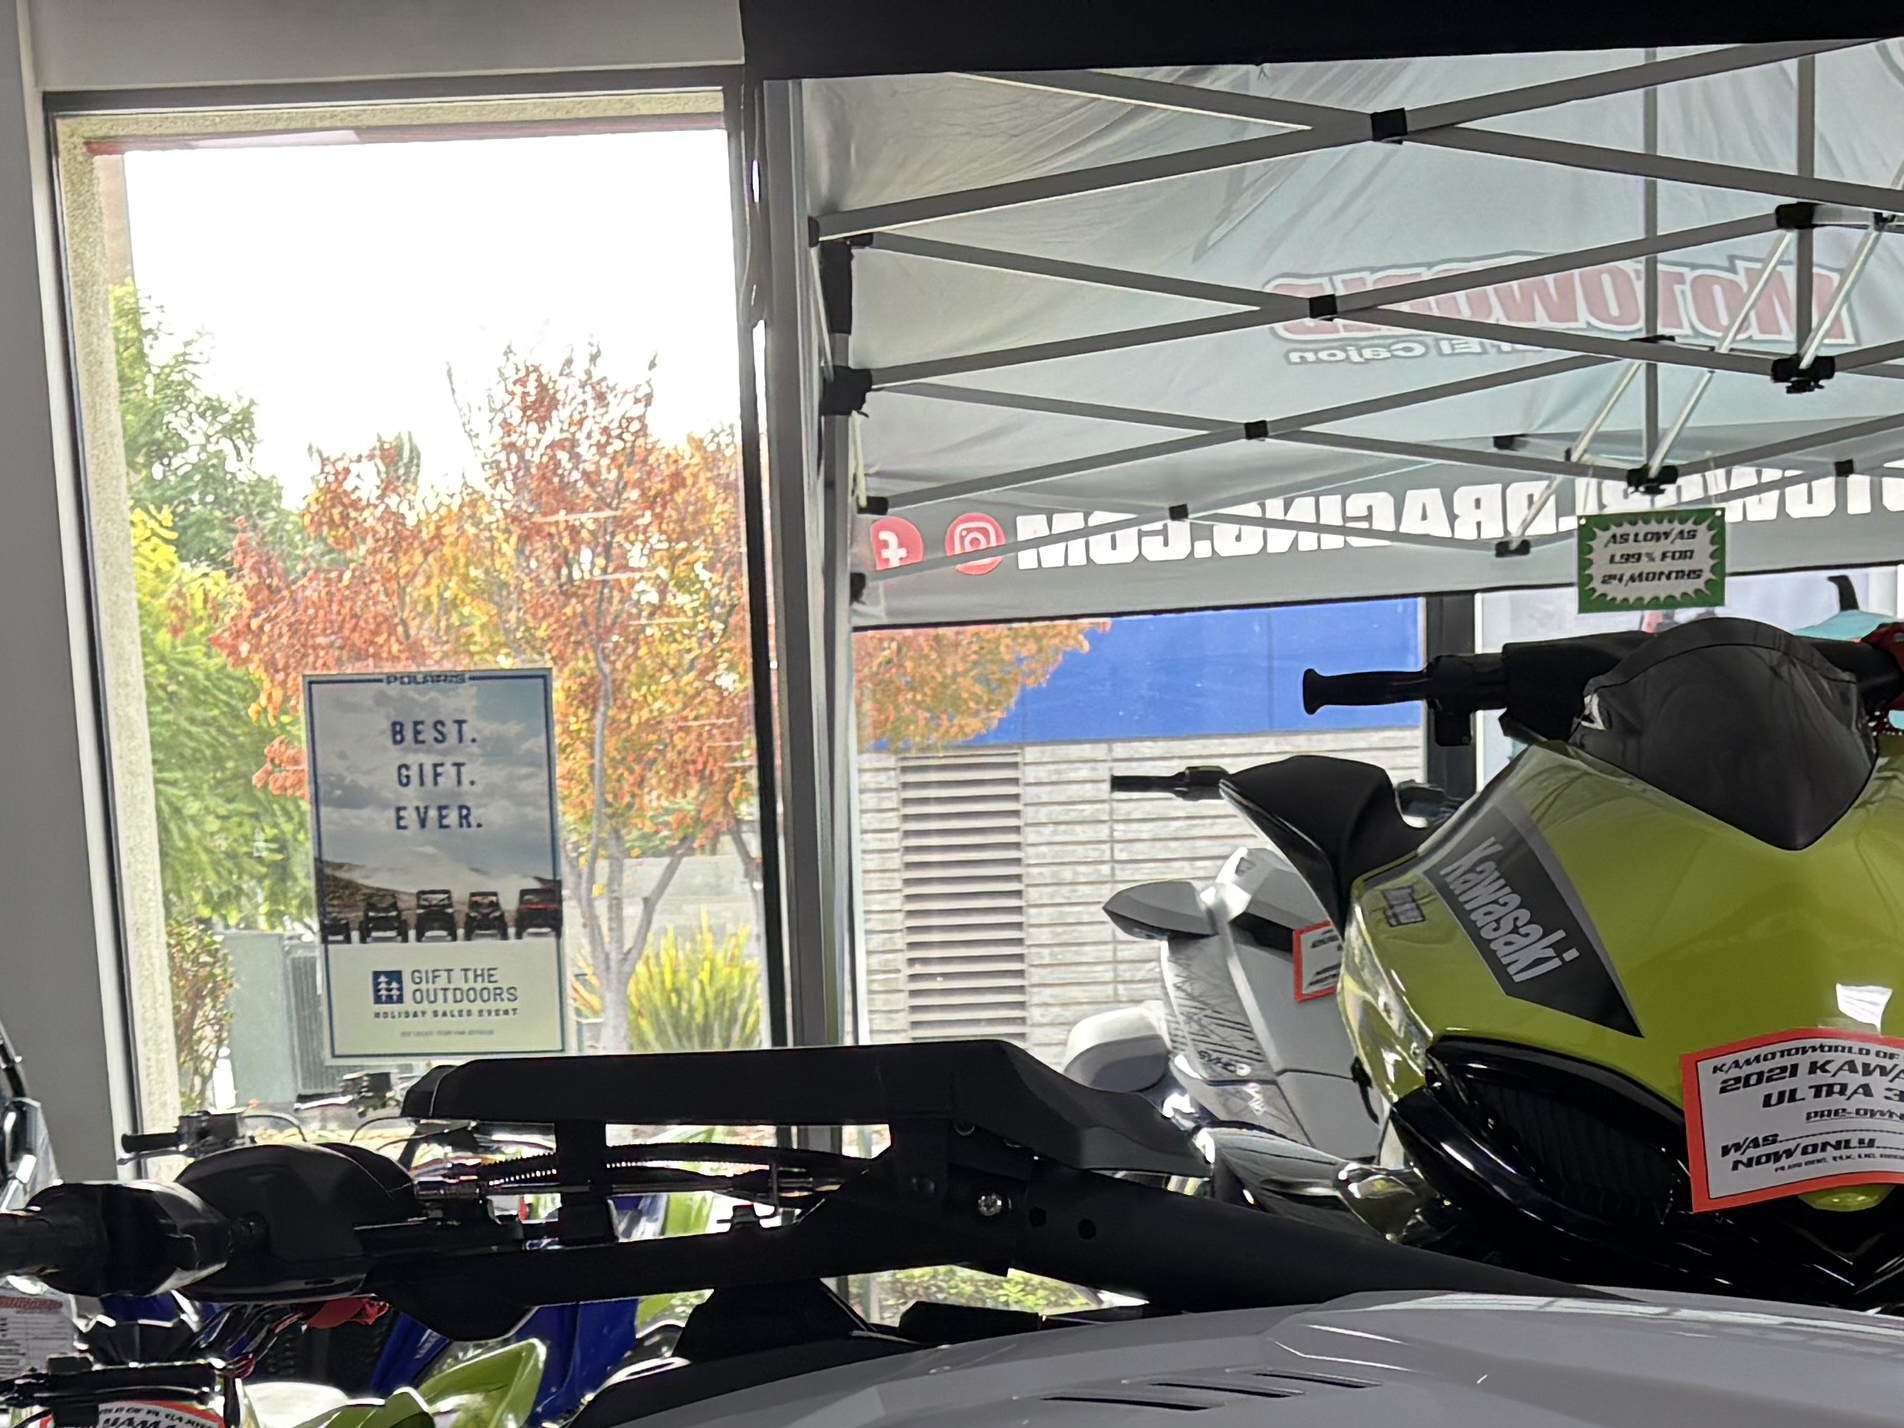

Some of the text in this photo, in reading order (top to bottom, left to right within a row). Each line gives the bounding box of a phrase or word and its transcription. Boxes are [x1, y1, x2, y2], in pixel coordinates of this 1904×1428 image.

[391, 720, 477, 745] BEST.
[397, 762, 475, 787] GIFT.
[396, 805, 483, 830] EVER.
[1439, 836, 1580, 983] Kawasaki
[411, 967, 498, 985] GIFT THE
[412, 987, 518, 1004] OUTDOORS
[1875, 1050, 1900, 1061] OF
[1719, 1063, 1799, 1095] 2021
[1762, 1083, 1875, 1108] ULTRA
